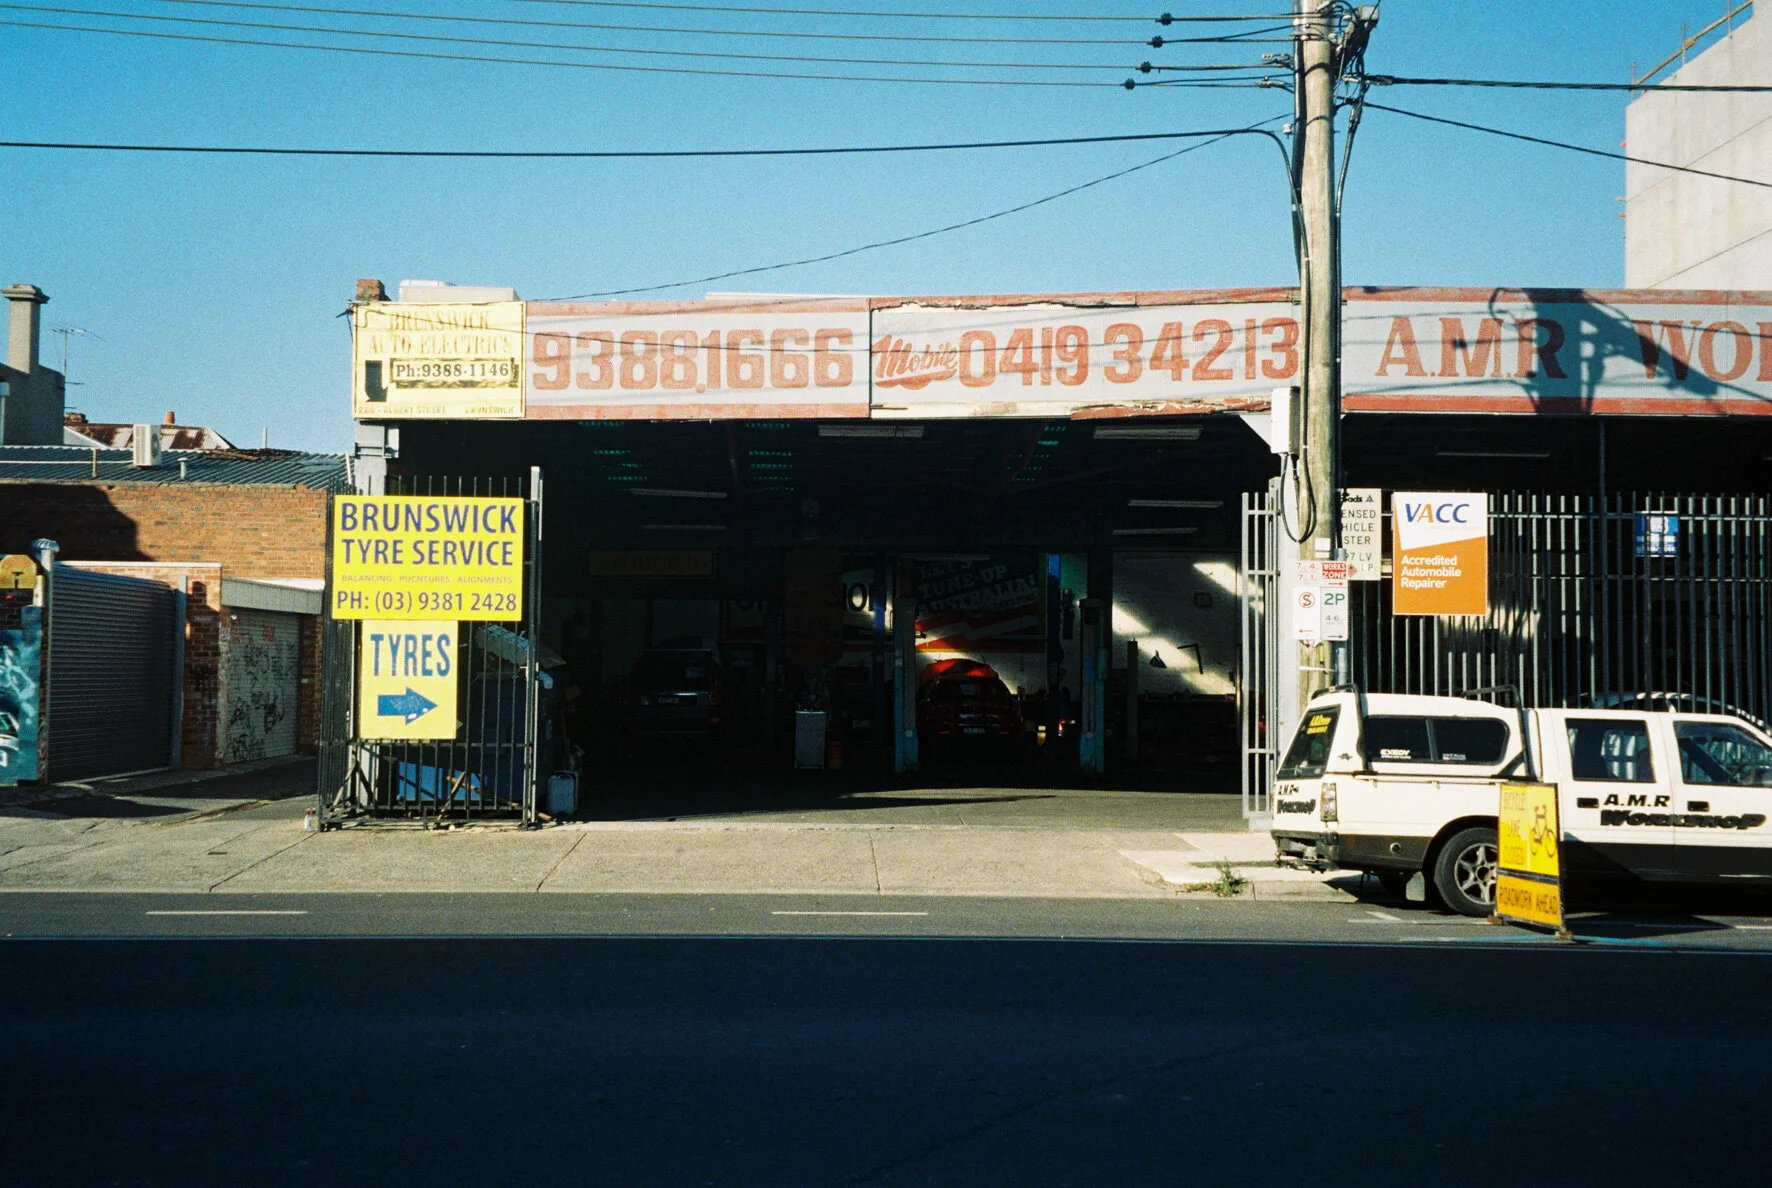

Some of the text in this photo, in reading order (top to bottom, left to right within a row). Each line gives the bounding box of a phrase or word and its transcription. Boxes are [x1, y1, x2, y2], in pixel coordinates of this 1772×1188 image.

[389, 310, 490, 331] BRUNSWICK
[369, 334, 513, 354] AUTO ELECTRICS
[873, 332, 959, 379] Mobile
[959, 325, 1089, 388] 0419
[340, 503, 517, 534] BRUNSWICK
[1405, 503, 1470, 524] VACC
[342, 538, 514, 566] TYRE SERVICE
[1401, 555, 1458, 566] Accredited
[341, 574, 393, 583] BALANCING
[457, 576, 513, 585] ALIGNMENTS
[1323, 571, 1346, 579] ZONE
[1401, 566, 1461, 577] Automobile
[1401, 577, 1448, 590] Repairer
[337, 590, 517, 613] PH: (03) 9381 2428
[1324, 593, 1345, 605] 2P
[370, 633, 451, 677] TYRES
[1380, 748, 1410, 756] EXEDY
[1603, 793, 1671, 807] A.M.R
